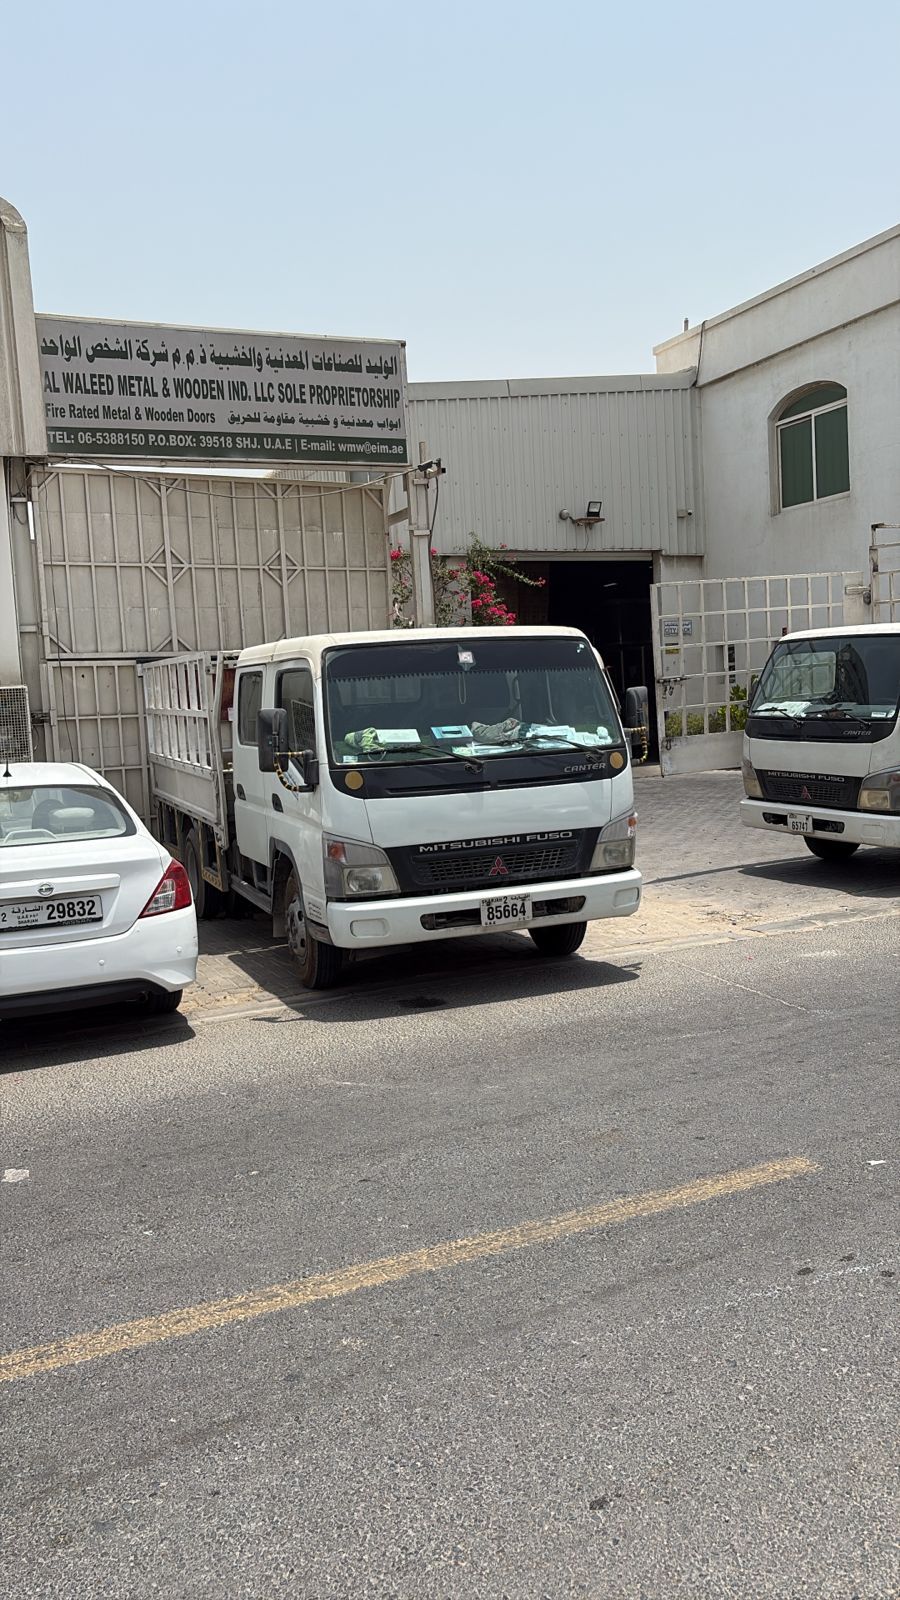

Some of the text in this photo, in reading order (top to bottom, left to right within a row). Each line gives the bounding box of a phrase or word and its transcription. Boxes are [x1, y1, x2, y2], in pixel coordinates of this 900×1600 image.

[40, 334, 82, 362] الواحد
[85, 337, 133, 363] الشخص
[135, 339, 169, 367] شركة
[209, 343, 263, 373] والخشبية
[265, 347, 309, 373] المعدنية
[311, 351, 363, 373] للصناعات
[365, 355, 398, 379] الوليد
[44, 371, 400, 409] AL WALEED METAL & WOODEN IND. LLC SOLE PROPRIETORSHIP
[45, 403, 216, 424] Fire Rated Metal & Wooden Doors
[227, 410, 260, 425] للحريق
[263, 411, 296, 427] مقاومة
[298, 412, 330, 428] خشبية
[333, 418, 339, 429] و
[340, 415, 374, 430] معدنية
[48, 431, 74, 444] TEL:
[77, 431, 145, 446] 06-5388150
[148, 434, 197, 447] P.O.BOX:
[199, 435, 233, 448] 39518
[235, 436, 261, 449] SHJ.
[264, 437, 292, 450] U.A.E
[301, 439, 336, 452] E-mail:
[338, 441, 404, 454] wmw@eim.ae
[564, 762, 606, 773] CANTER
[768, 771, 815, 779] MITSUBISHI
[419, 831, 573, 852] MITSUBISHI FUSO
[46, 899, 97, 920] 29832
[503, 896, 508, 904] 2
[1, 912, 7, 922] 2
[487, 902, 527, 921] 85664
